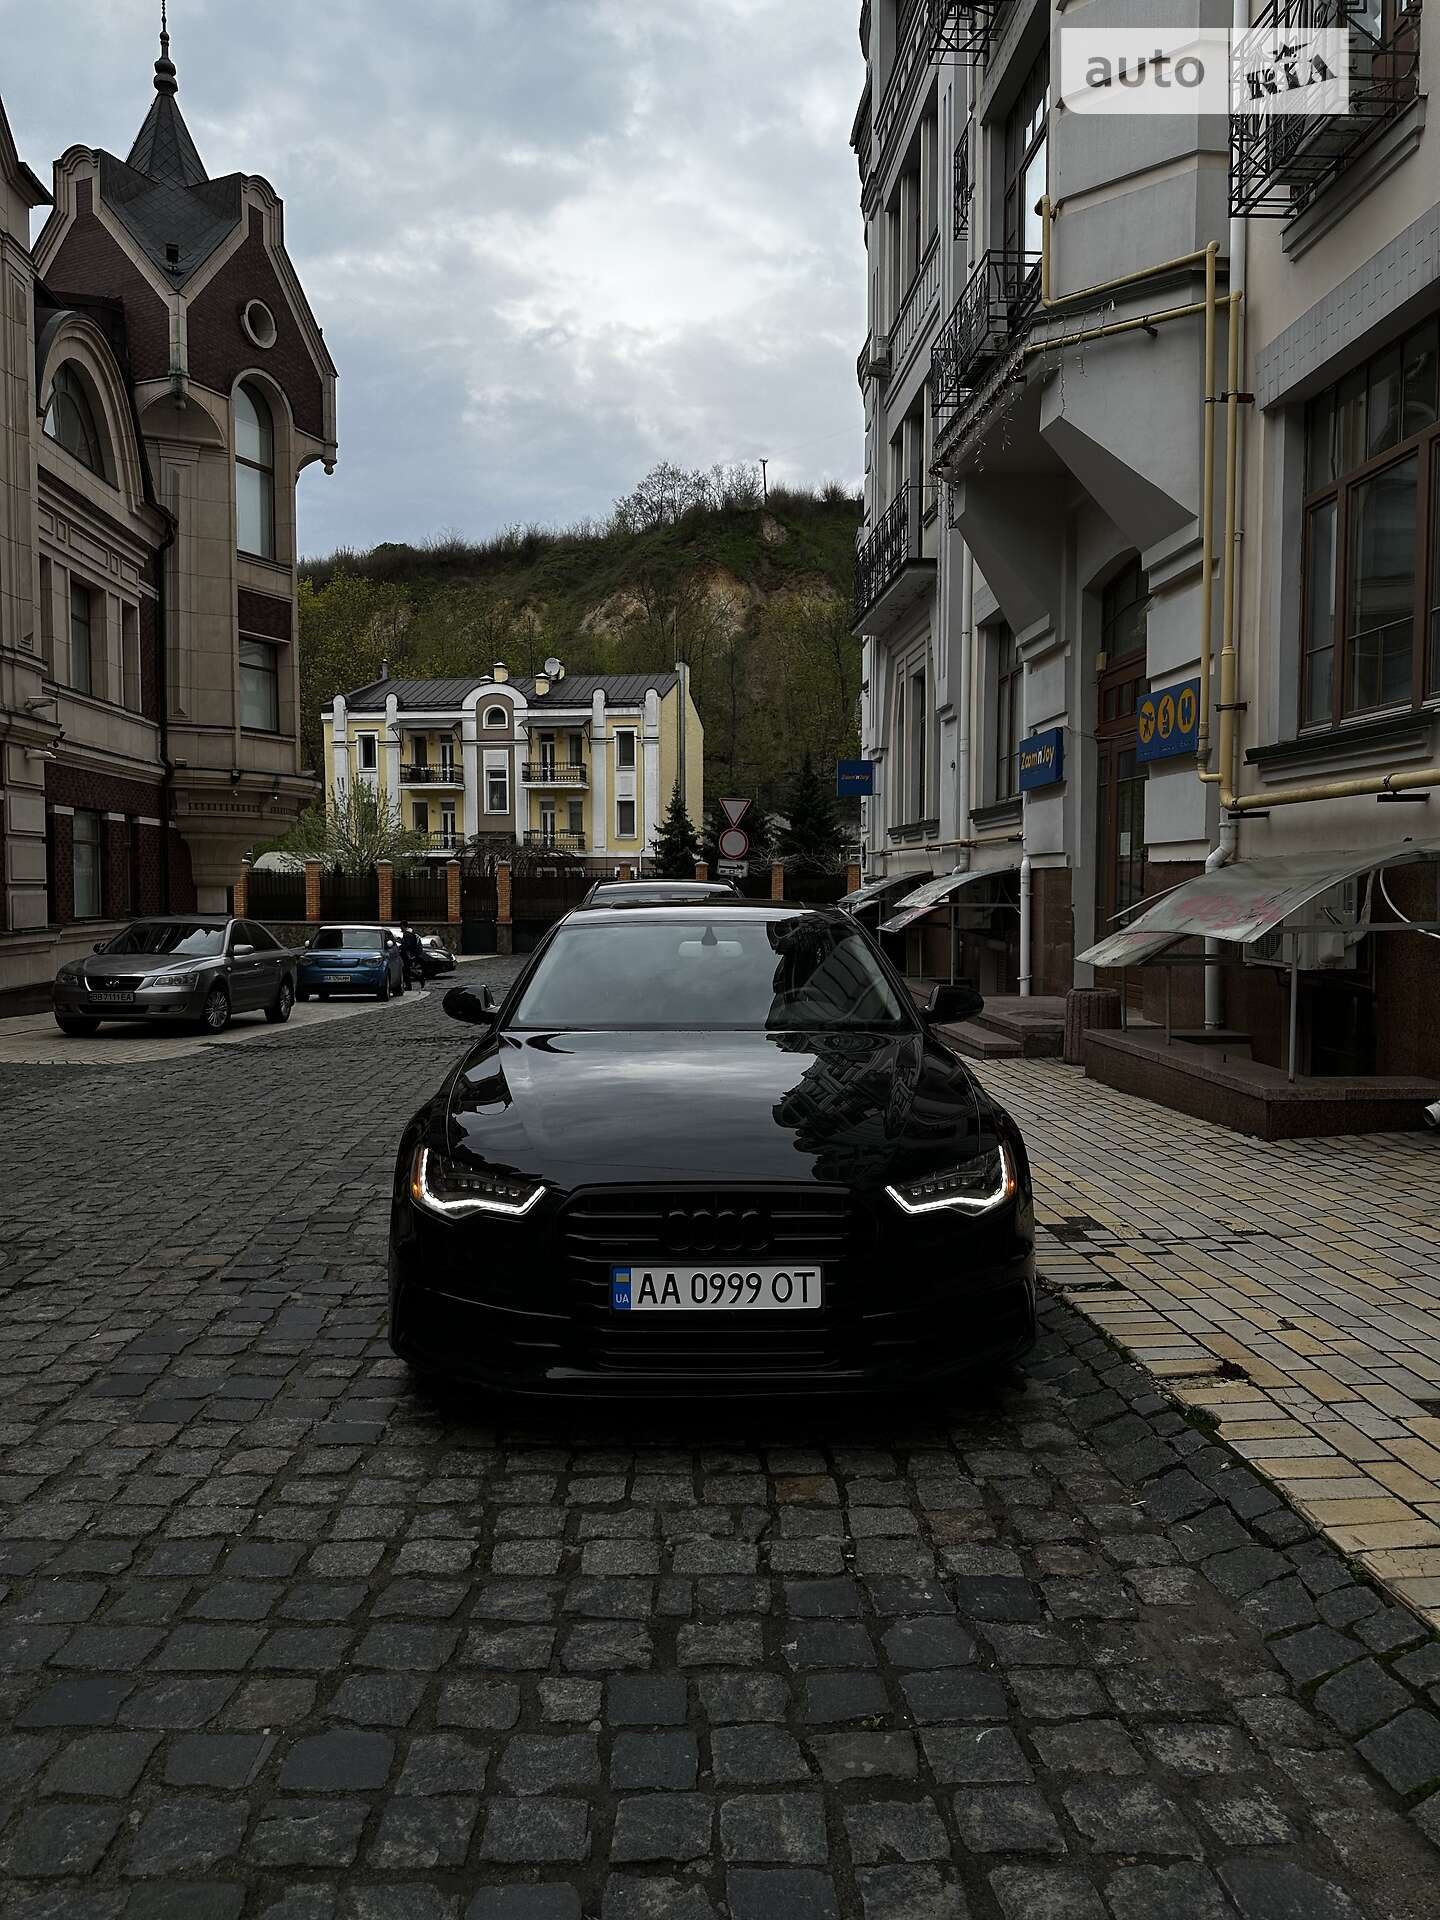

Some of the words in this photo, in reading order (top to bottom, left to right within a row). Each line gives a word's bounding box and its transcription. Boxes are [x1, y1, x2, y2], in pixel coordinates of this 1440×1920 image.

[615, 1293, 629, 1304] UA
[637, 1272, 681, 1304] AA
[690, 1272, 762, 1304] 0999
[771, 1271, 816, 1304] OT
